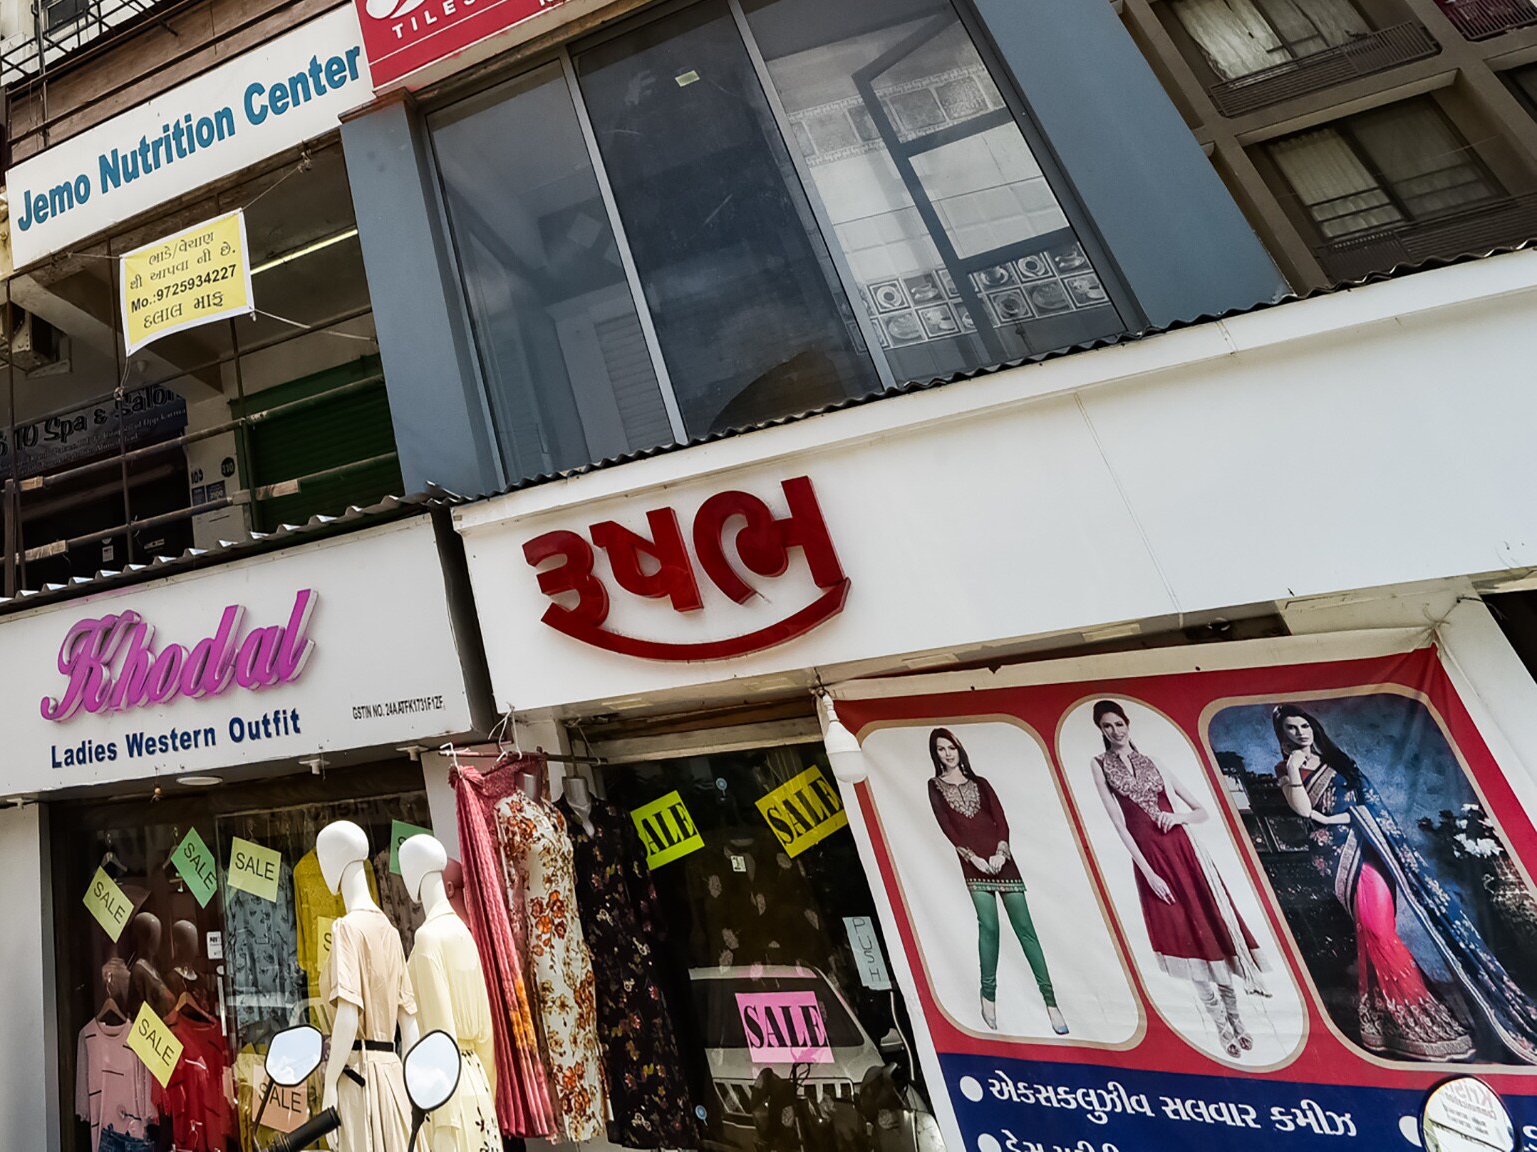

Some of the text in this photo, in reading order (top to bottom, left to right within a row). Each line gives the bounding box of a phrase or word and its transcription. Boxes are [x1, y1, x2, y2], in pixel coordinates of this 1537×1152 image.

[18, 46, 361, 232] Jemo Nutrition Center
[14, 423, 39, 451] 10
[44, 415, 87, 444] Spa
[93, 408, 108, 426] &
[40, 588, 319, 724] Khodal
[51, 708, 302, 770] Ladies Western Outfit
[638, 801, 698, 856] ALE
[765, 774, 844, 847] SALE
[183, 841, 218, 890] SALE
[234, 851, 275, 882] SALE
[92, 880, 127, 924] SALE
[852, 917, 882, 982] PUSH
[137, 1018, 176, 1067] SALE
[743, 1004, 830, 1050] SALE
[1160, 1095, 1261, 1129] સલવાર
[1270, 1098, 1359, 1138] કમીઝ
